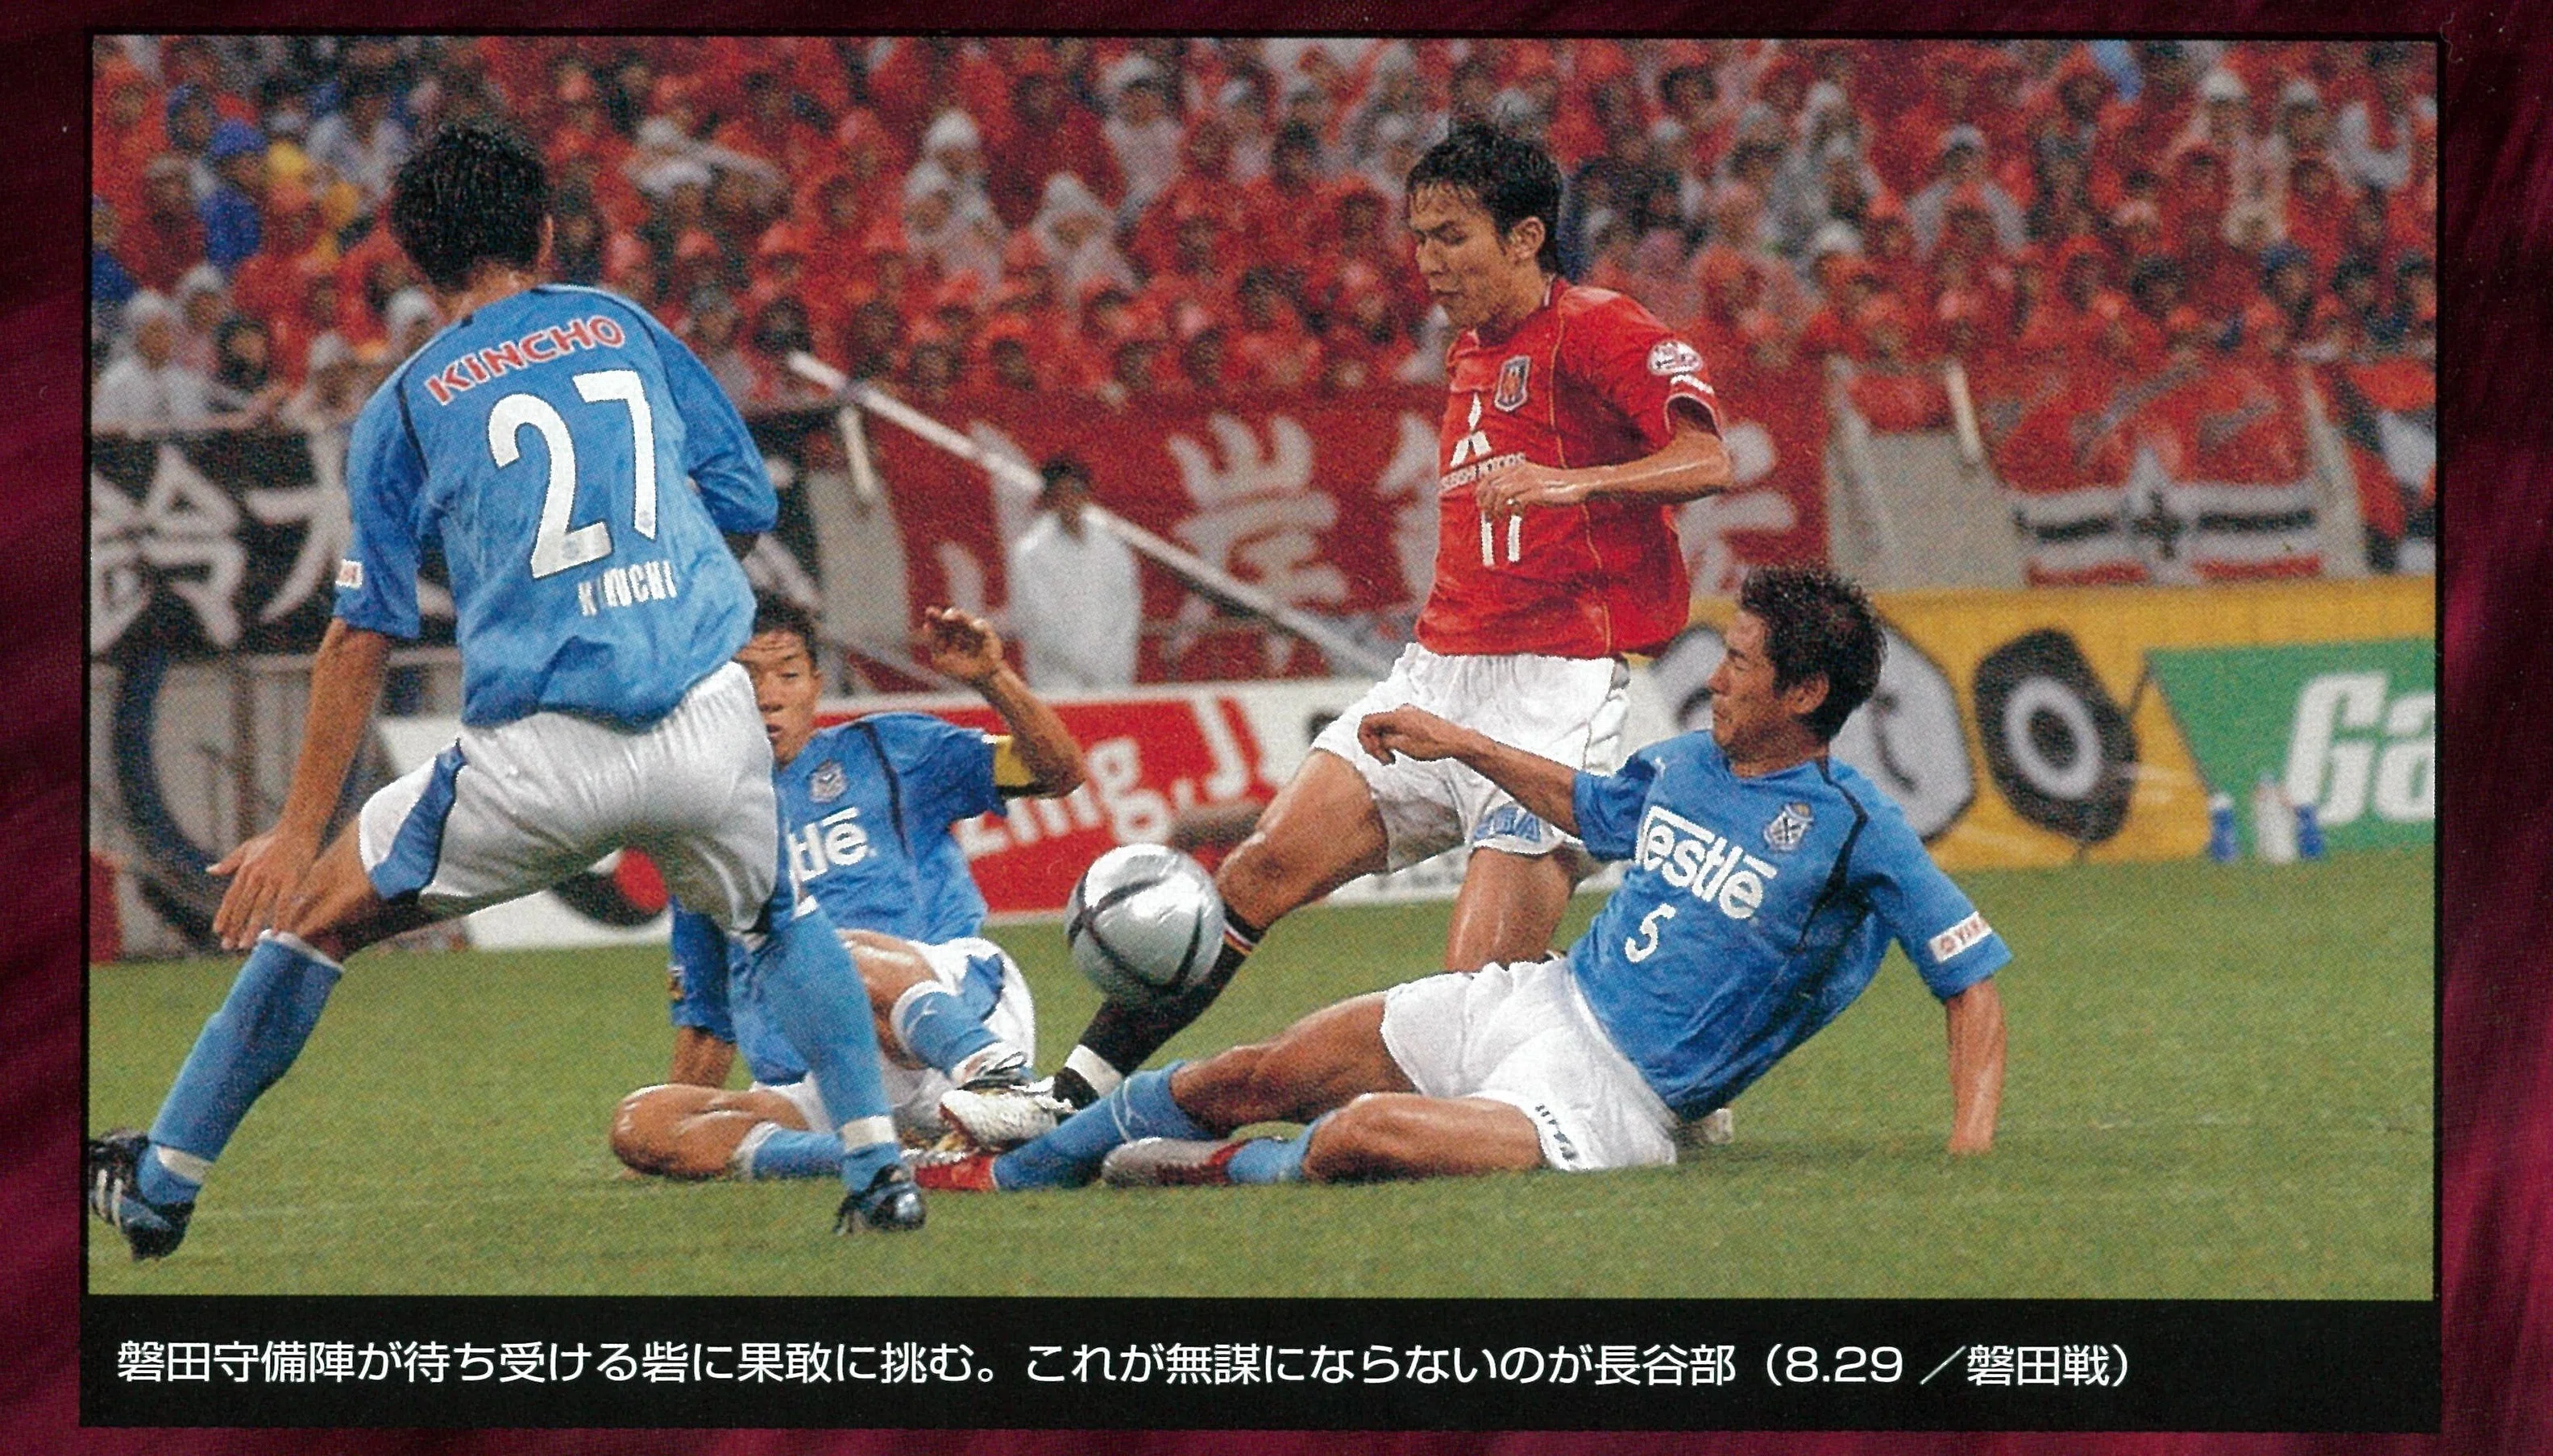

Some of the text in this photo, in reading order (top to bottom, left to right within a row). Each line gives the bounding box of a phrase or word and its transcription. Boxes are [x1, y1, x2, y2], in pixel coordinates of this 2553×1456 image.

[424, 314, 625, 405] KINCHO
[488, 368, 657, 580] 27
[1480, 511, 1522, 566] 11
[1625, 902, 1676, 963] 5
